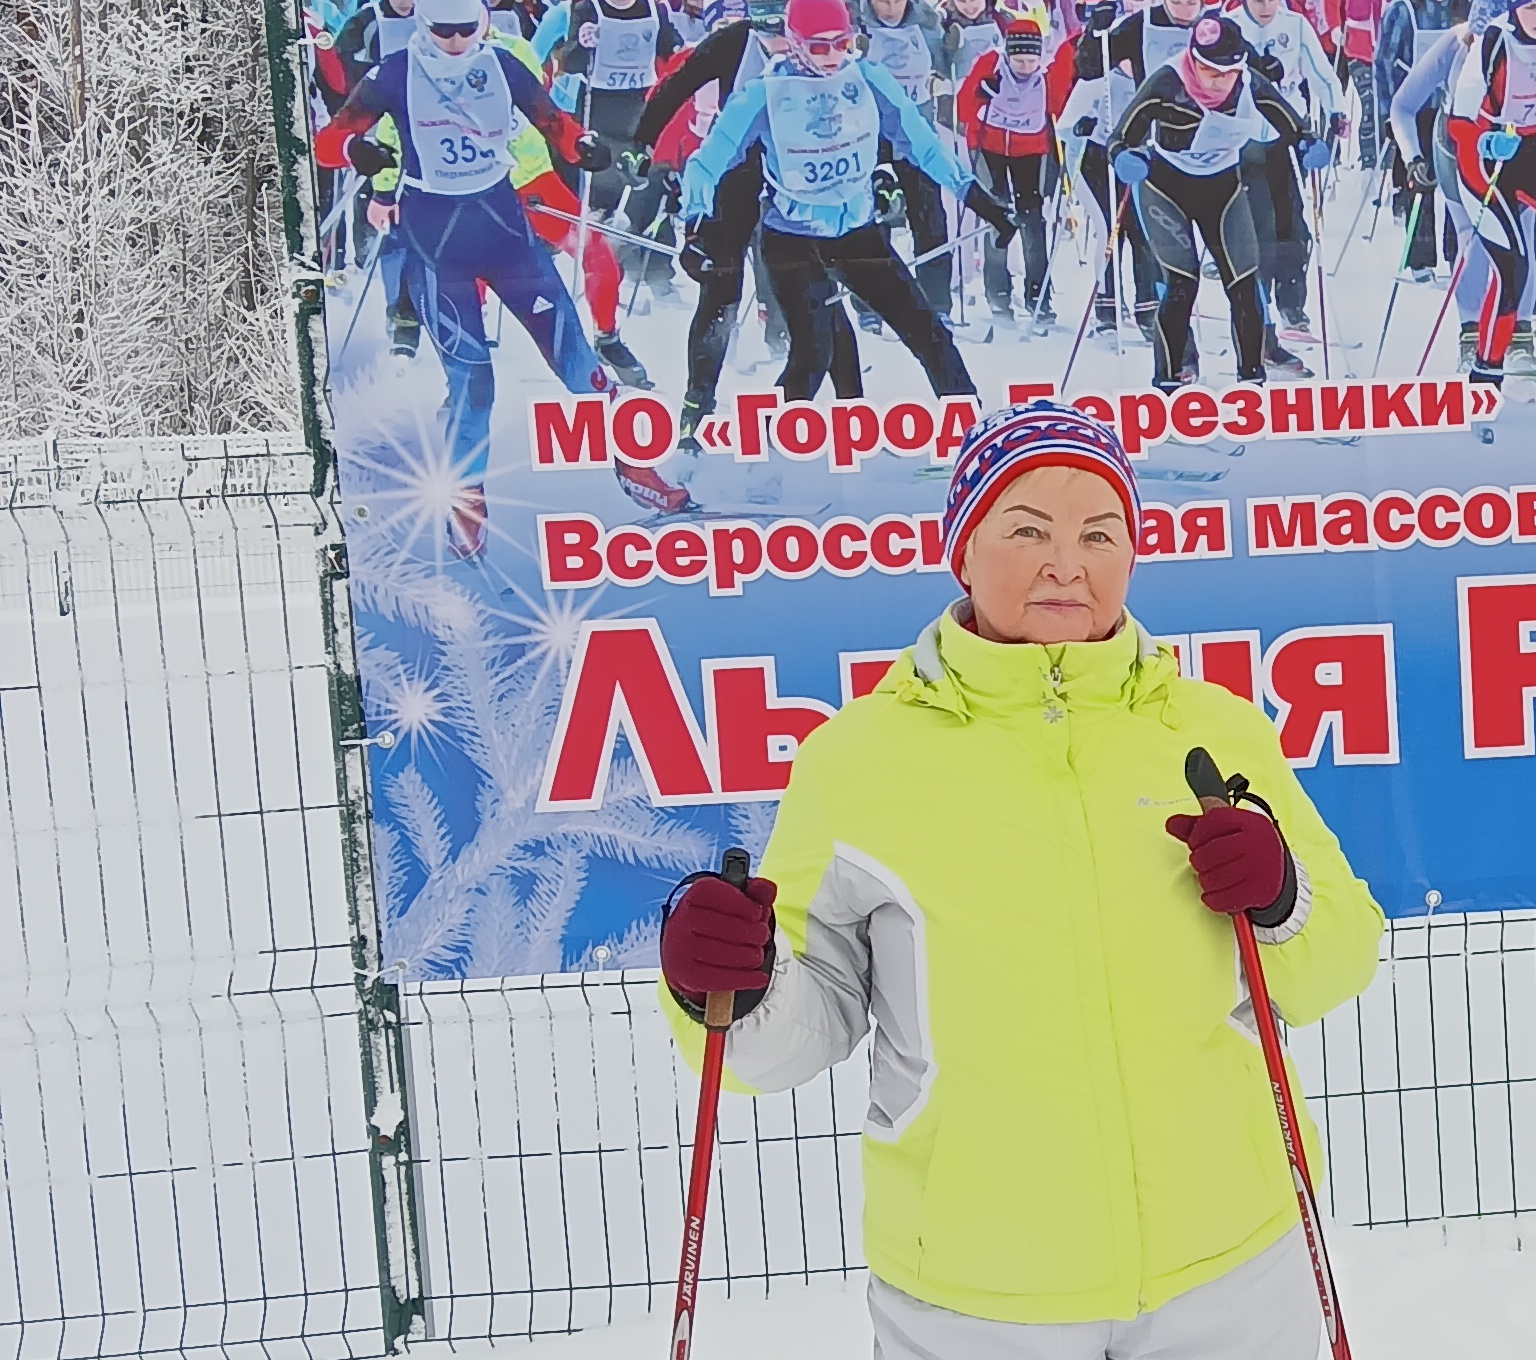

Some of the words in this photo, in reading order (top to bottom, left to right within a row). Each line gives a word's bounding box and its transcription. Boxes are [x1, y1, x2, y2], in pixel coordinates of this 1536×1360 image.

[803, 151, 861, 184] 3201
[533, 396, 674, 465] МО
[701, 392, 979, 468] «Город
[1008, 380, 1499, 456] ерезники»
